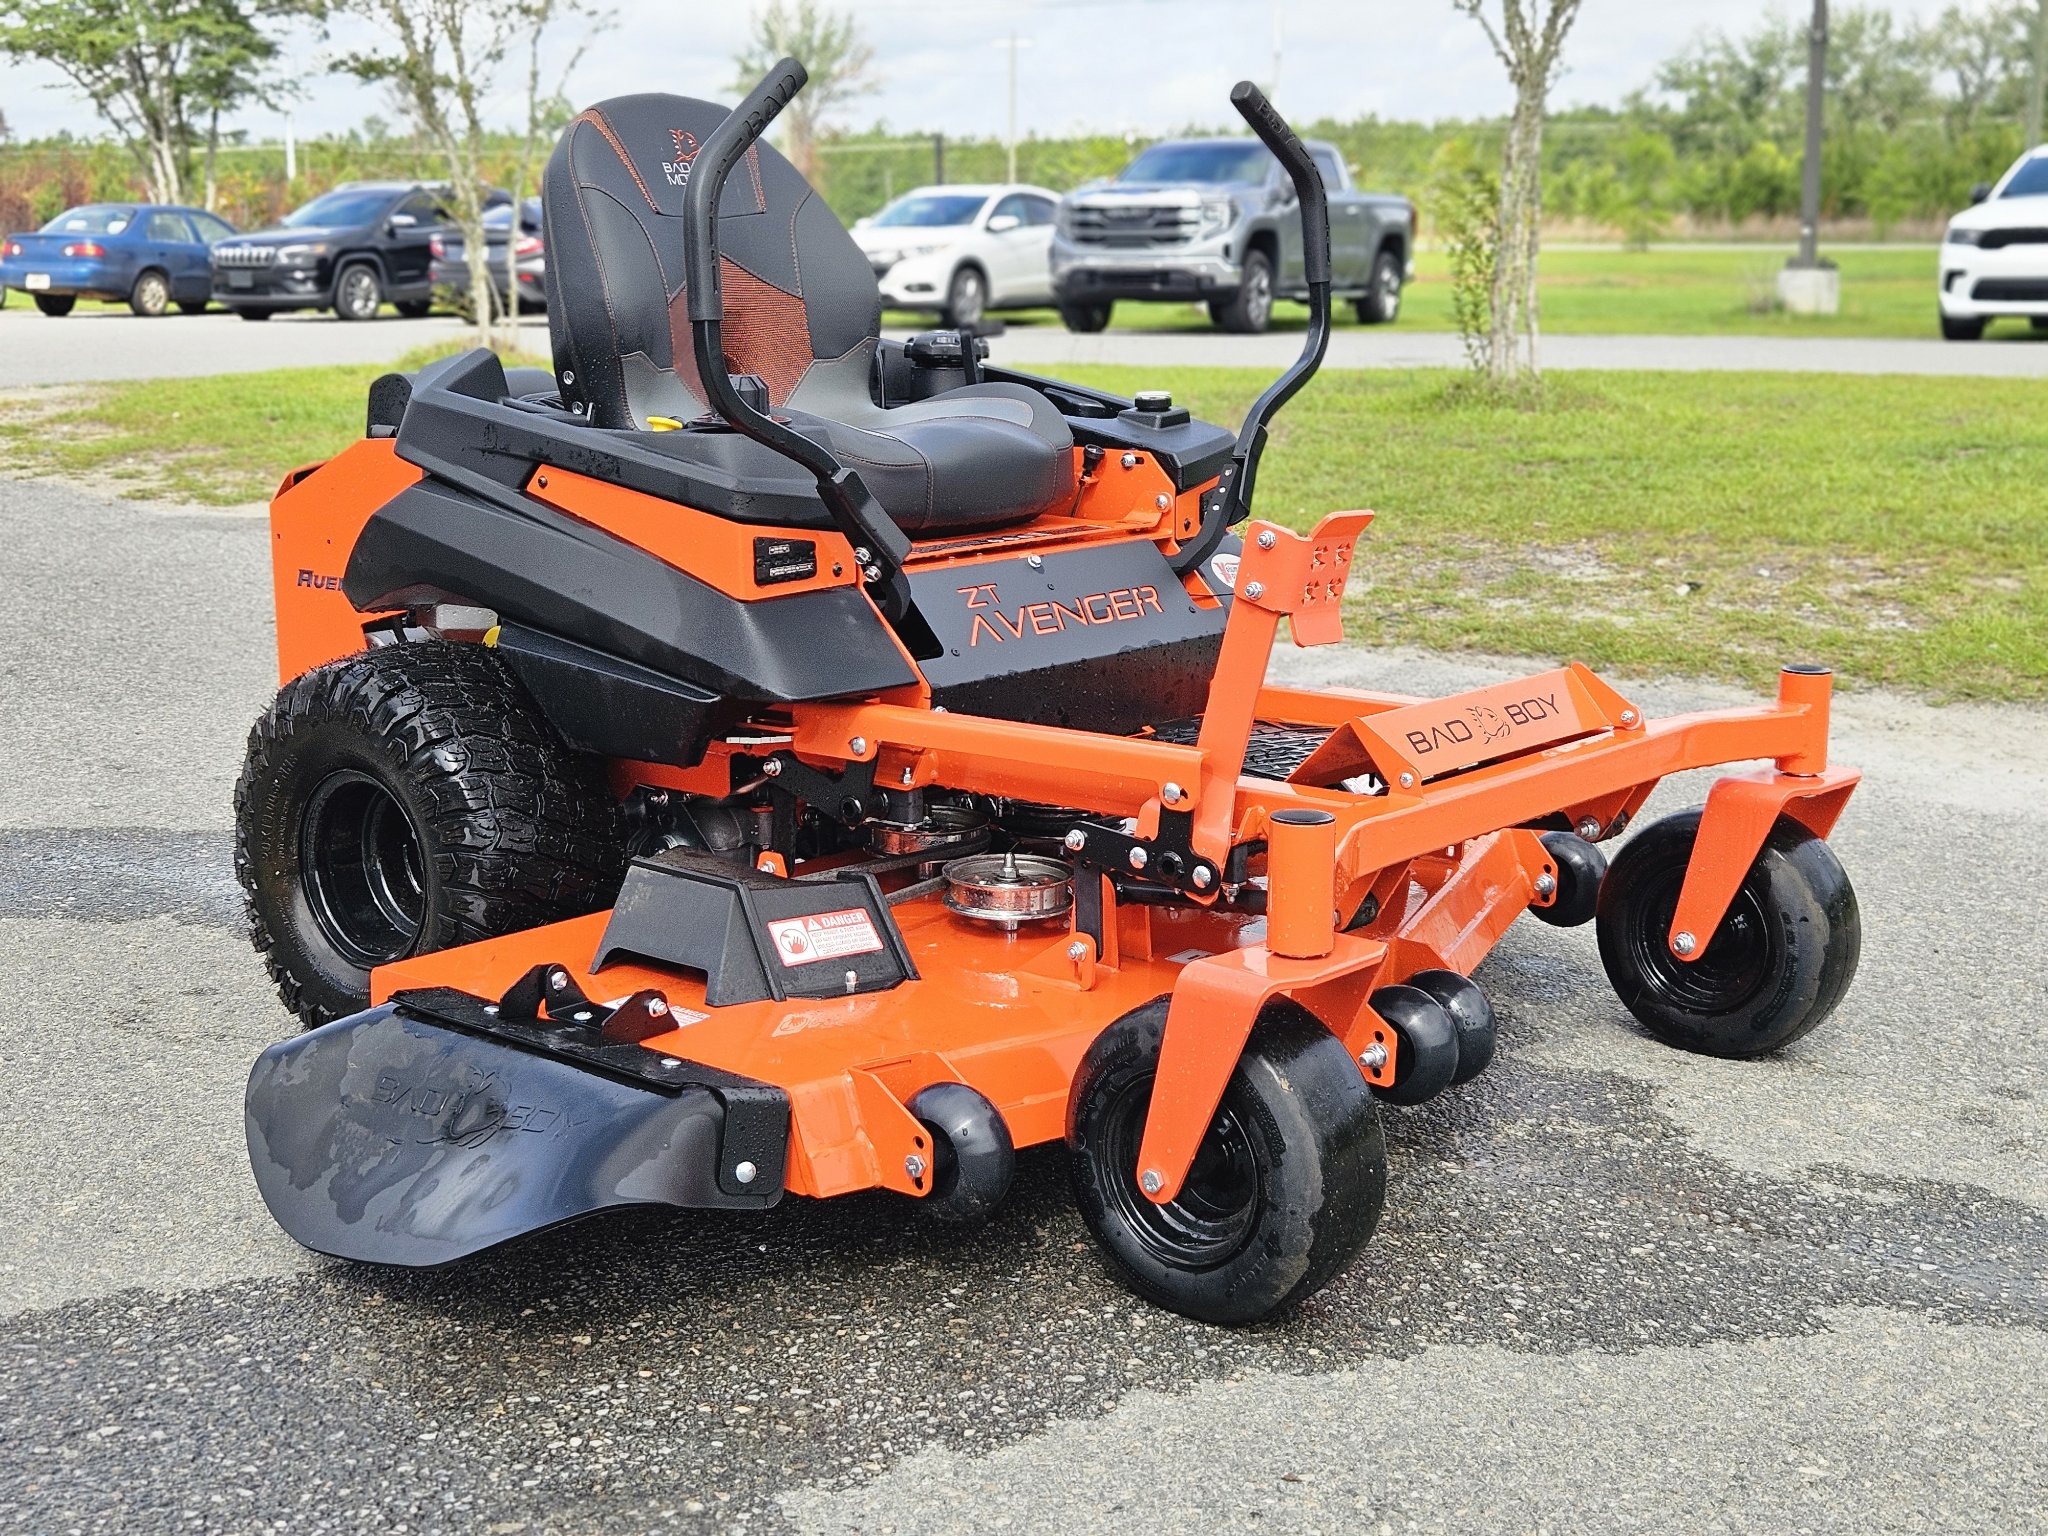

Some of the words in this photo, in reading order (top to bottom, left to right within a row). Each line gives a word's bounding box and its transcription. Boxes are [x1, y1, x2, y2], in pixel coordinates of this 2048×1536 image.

[742, 74, 798, 141] BAD
[661, 162, 691, 174] BAD
[957, 583, 1001, 609] ZT
[969, 585, 1165, 647] AVENGER
[1405, 719, 1474, 755] BAD
[1503, 693, 1560, 726] BOY
[821, 913, 866, 928] DANGER
[372, 1075, 450, 1118] BAD
[500, 1104, 591, 1140] BOY
